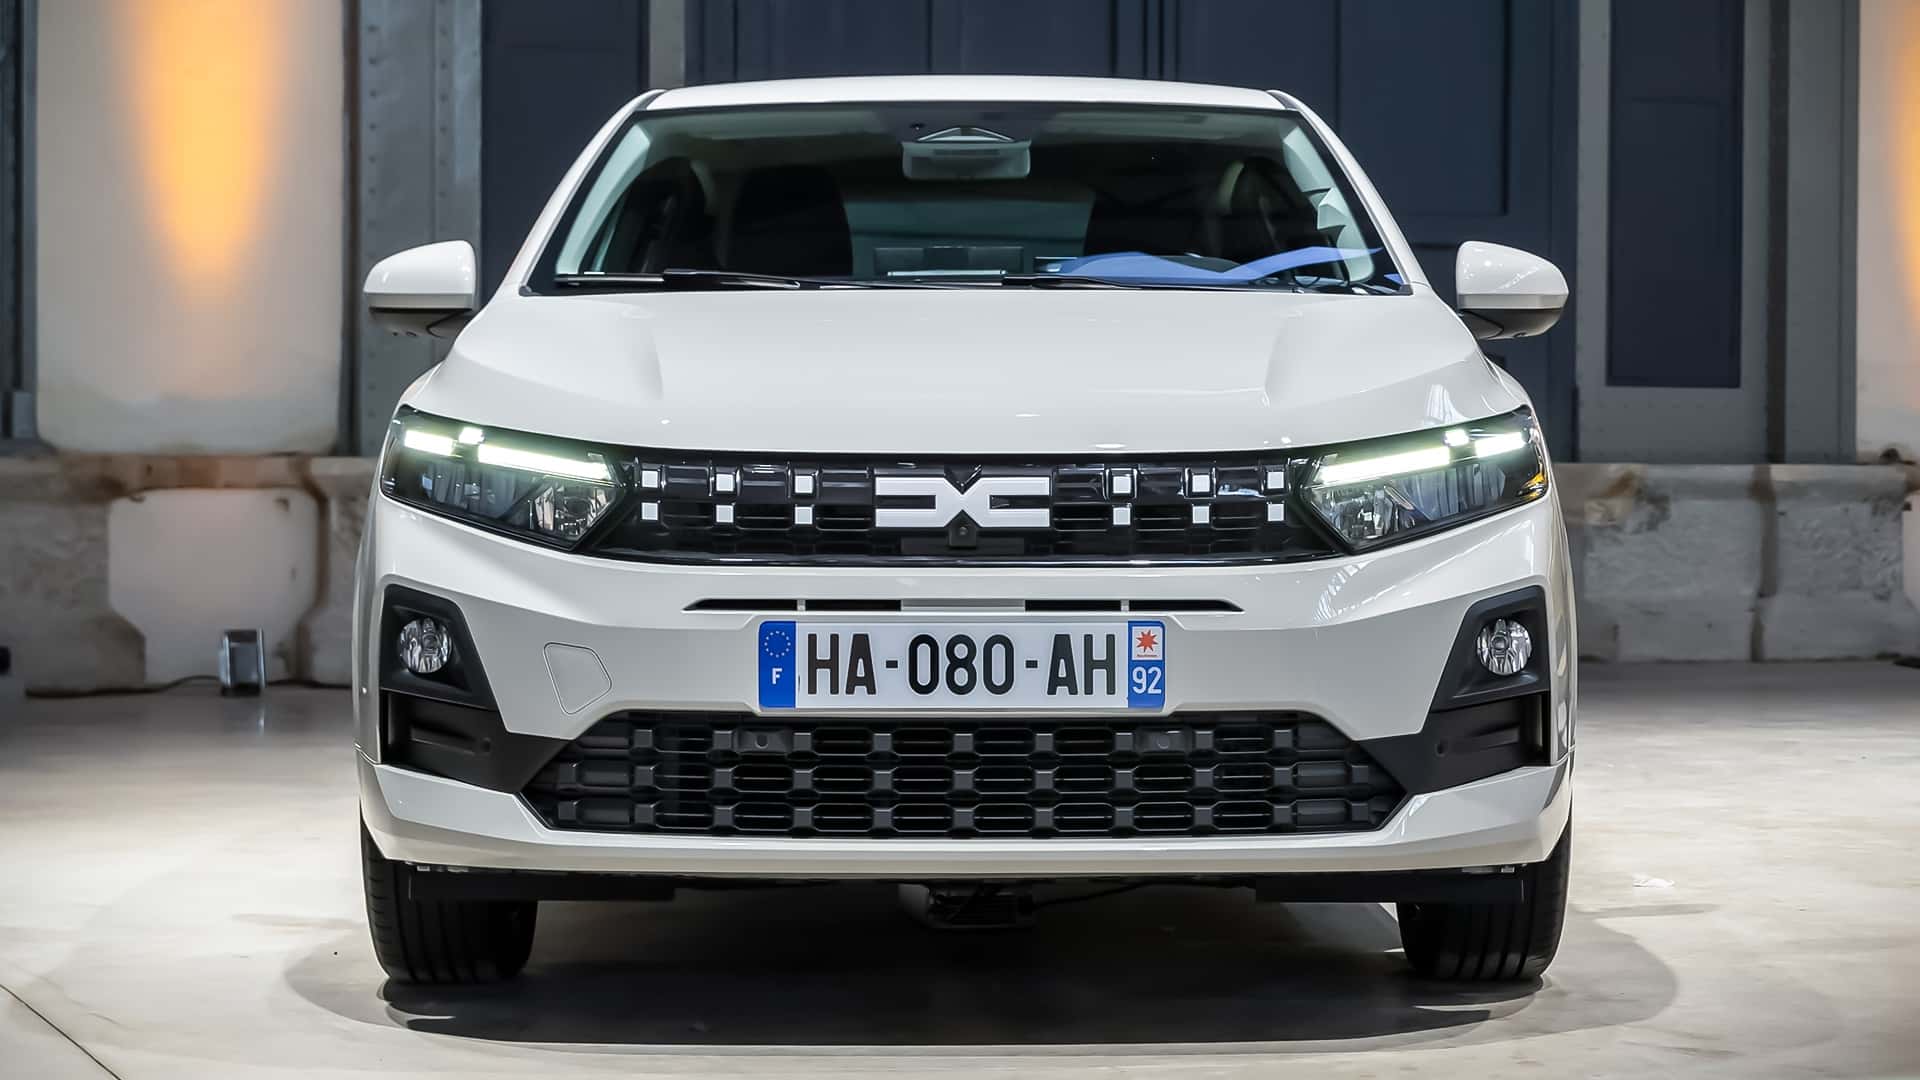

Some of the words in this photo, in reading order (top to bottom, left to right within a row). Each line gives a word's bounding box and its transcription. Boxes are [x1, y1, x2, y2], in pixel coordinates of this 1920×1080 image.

[772, 667, 783, 685] F
[807, 633, 1116, 696] HA-080-AH
[1132, 666, 1162, 694] 92
